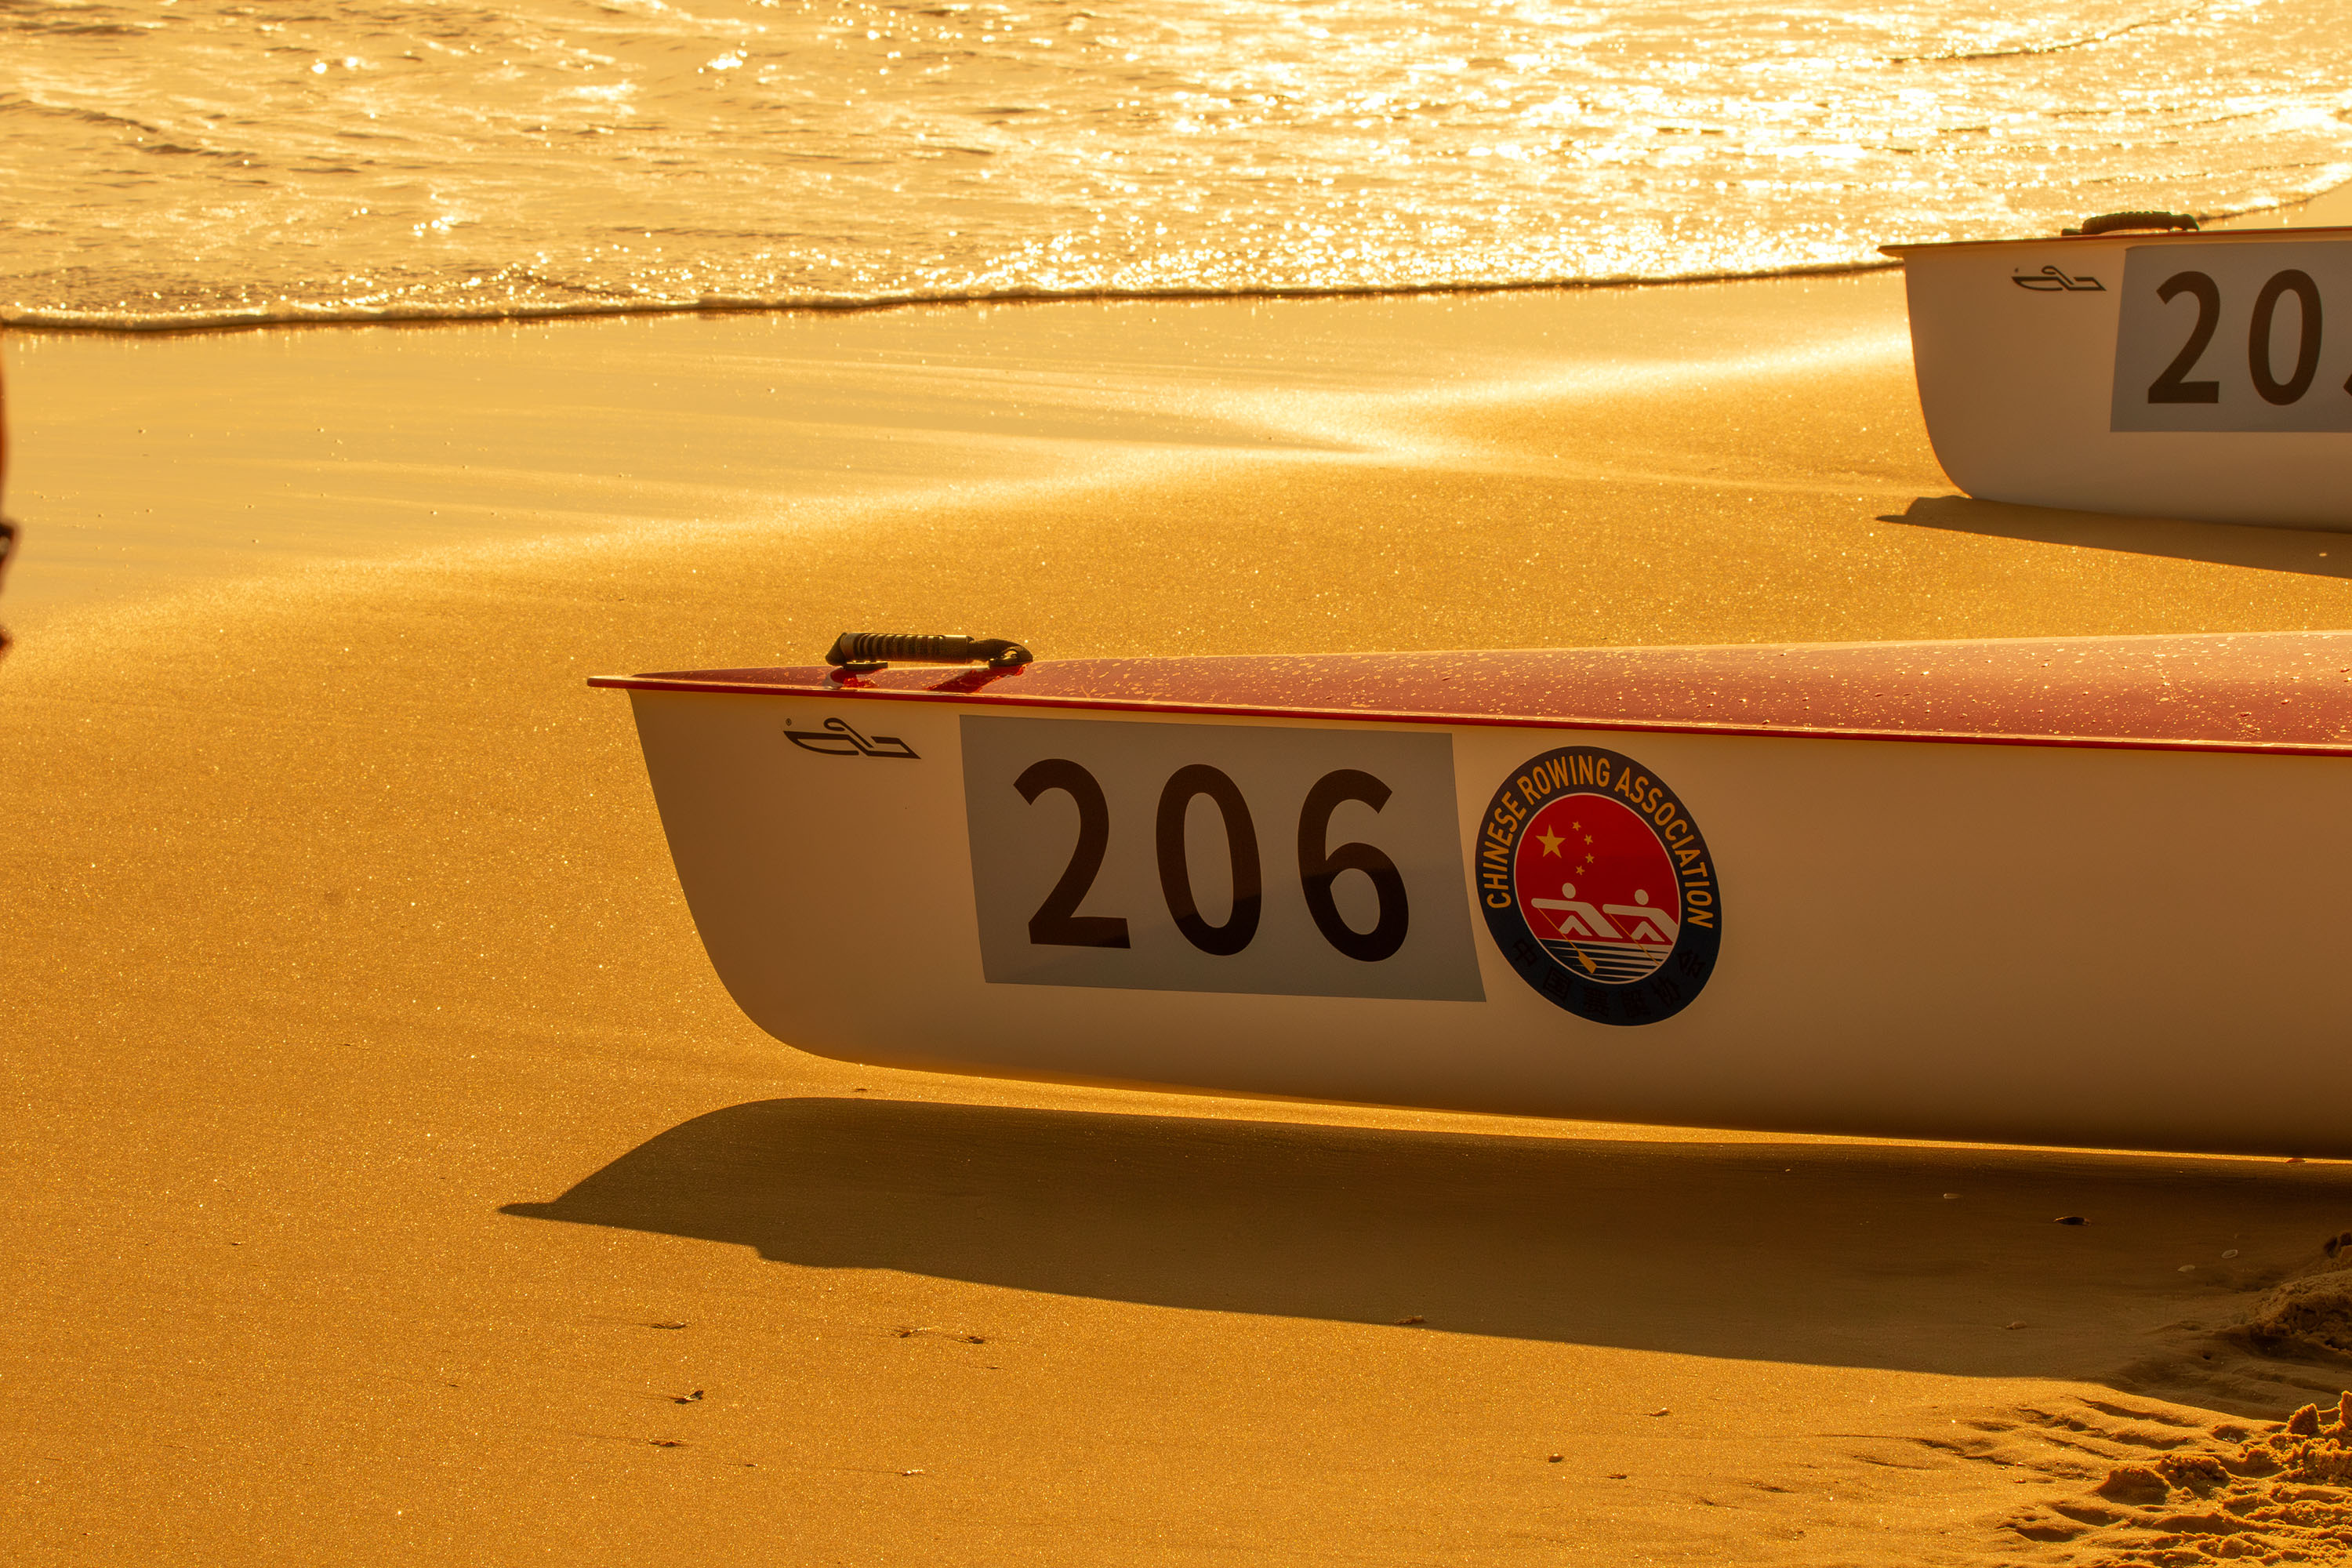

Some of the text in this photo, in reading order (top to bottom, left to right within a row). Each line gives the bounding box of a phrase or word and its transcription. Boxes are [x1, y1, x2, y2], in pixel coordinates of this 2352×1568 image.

[2147, 269, 2352, 405] 20
[1013, 758, 1410, 962] 206
[1483, 754, 1714, 929] CHINESE ROWING ASSOCIATION
